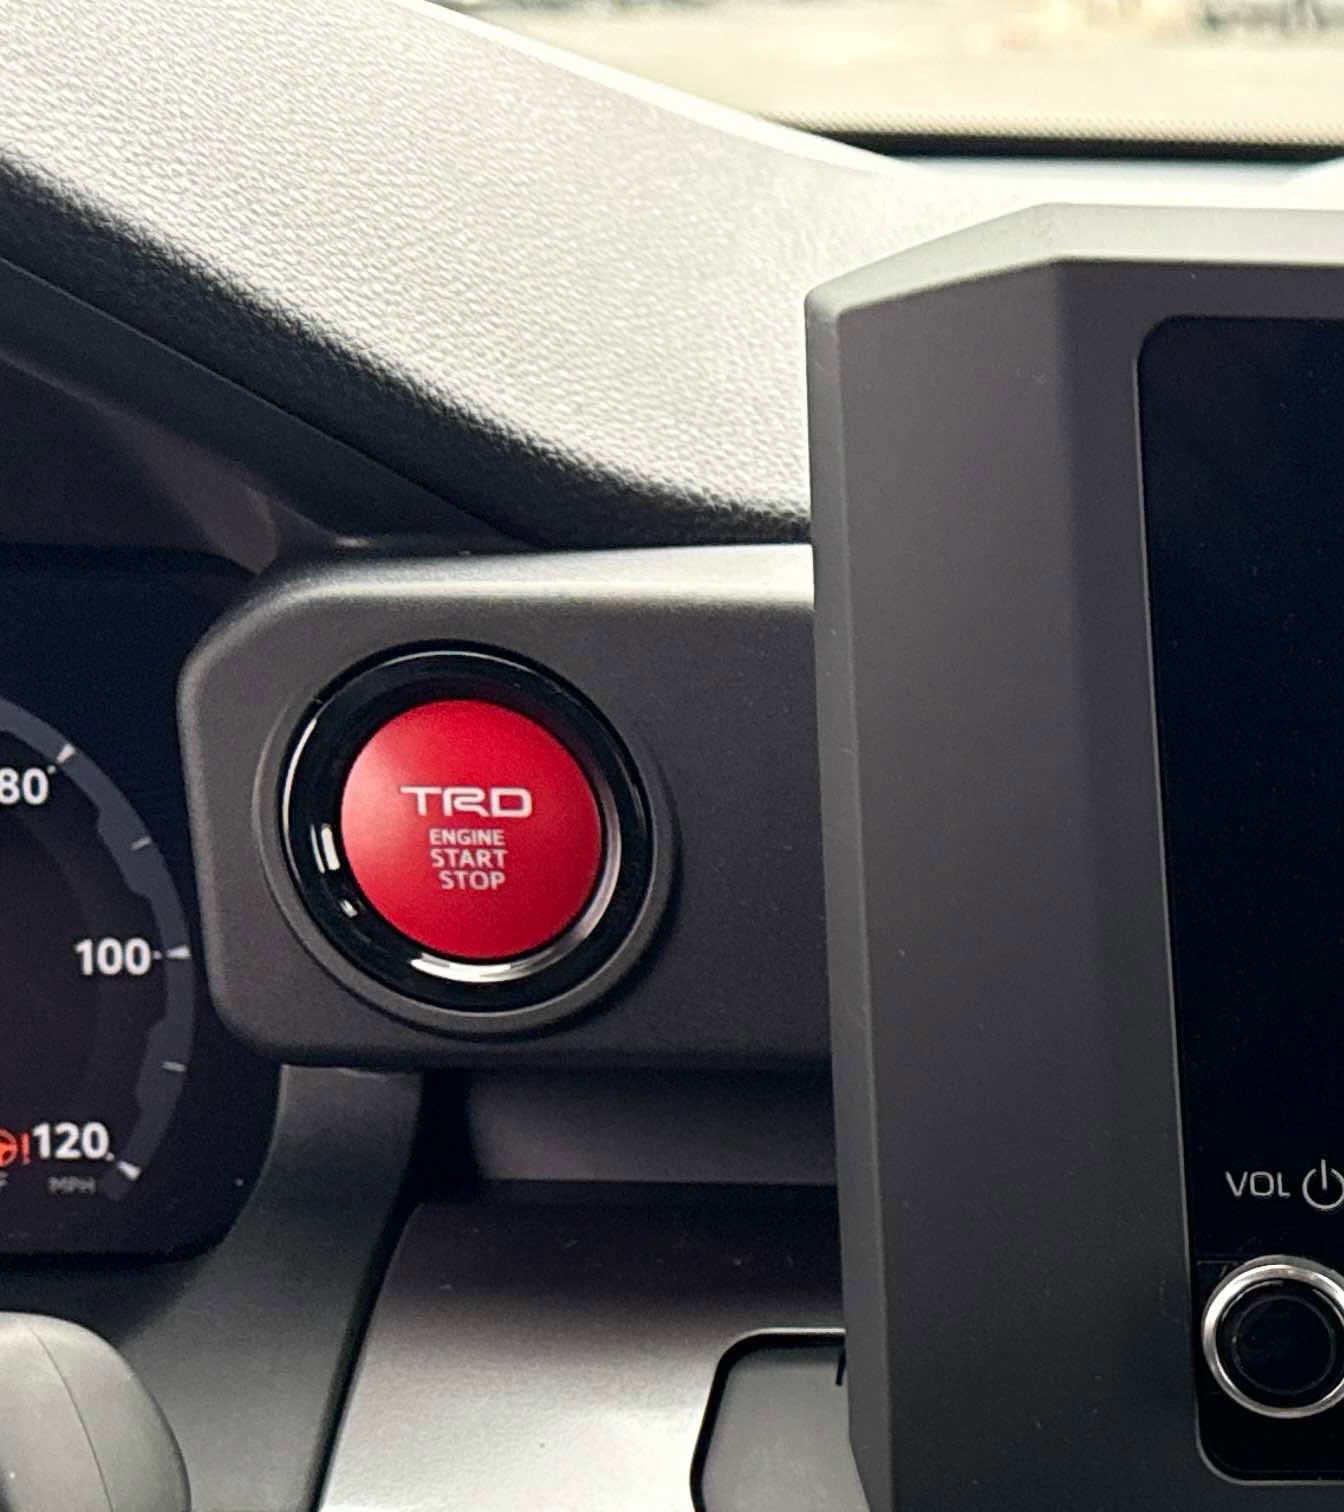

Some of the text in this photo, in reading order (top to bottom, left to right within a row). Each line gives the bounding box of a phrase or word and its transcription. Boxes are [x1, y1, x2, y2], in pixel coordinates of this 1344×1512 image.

[0, 767, 49, 805] 80
[400, 786, 533, 818] TRD
[428, 828, 507, 847] ENGINE
[430, 849, 509, 868] START
[438, 870, 507, 890] STOP
[74, 937, 151, 976] 100
[32, 1121, 109, 1160] 120
[1225, 1170, 1291, 1197] VOL
